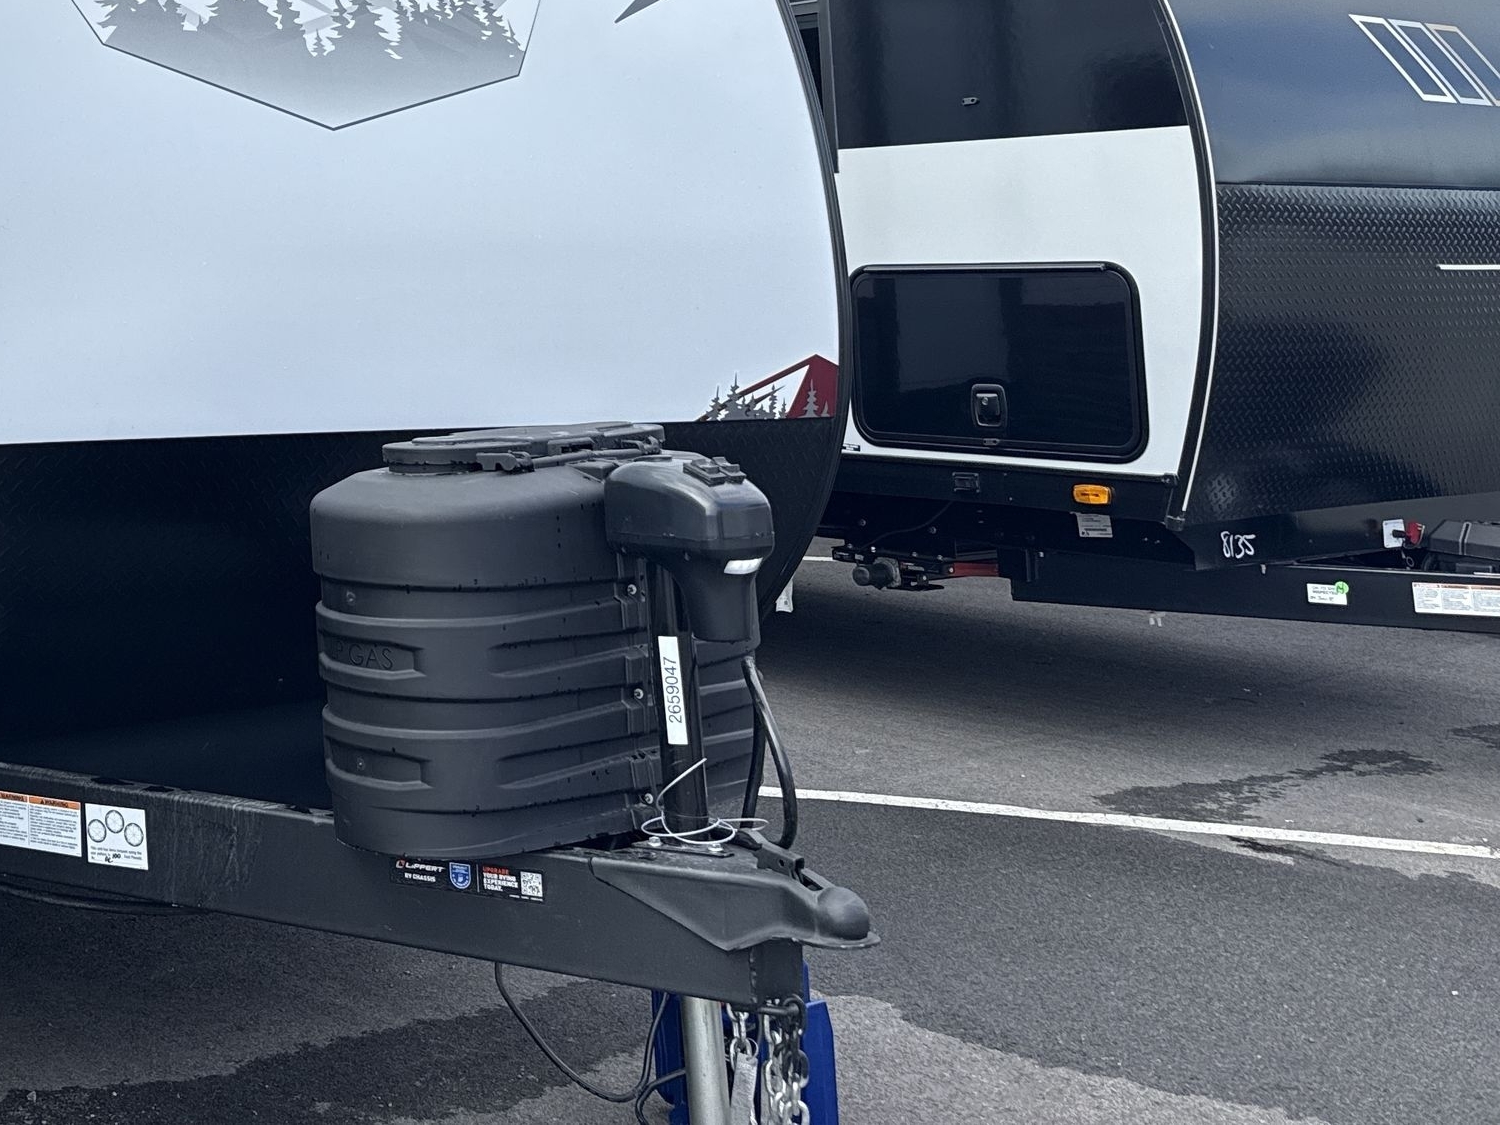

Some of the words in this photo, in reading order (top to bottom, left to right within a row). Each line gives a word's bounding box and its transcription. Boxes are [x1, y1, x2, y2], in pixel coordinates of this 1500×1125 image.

[1220, 531, 1256, 559] 8135
[348, 642, 394, 670] GAS
[663, 656, 683, 724] 2659047
